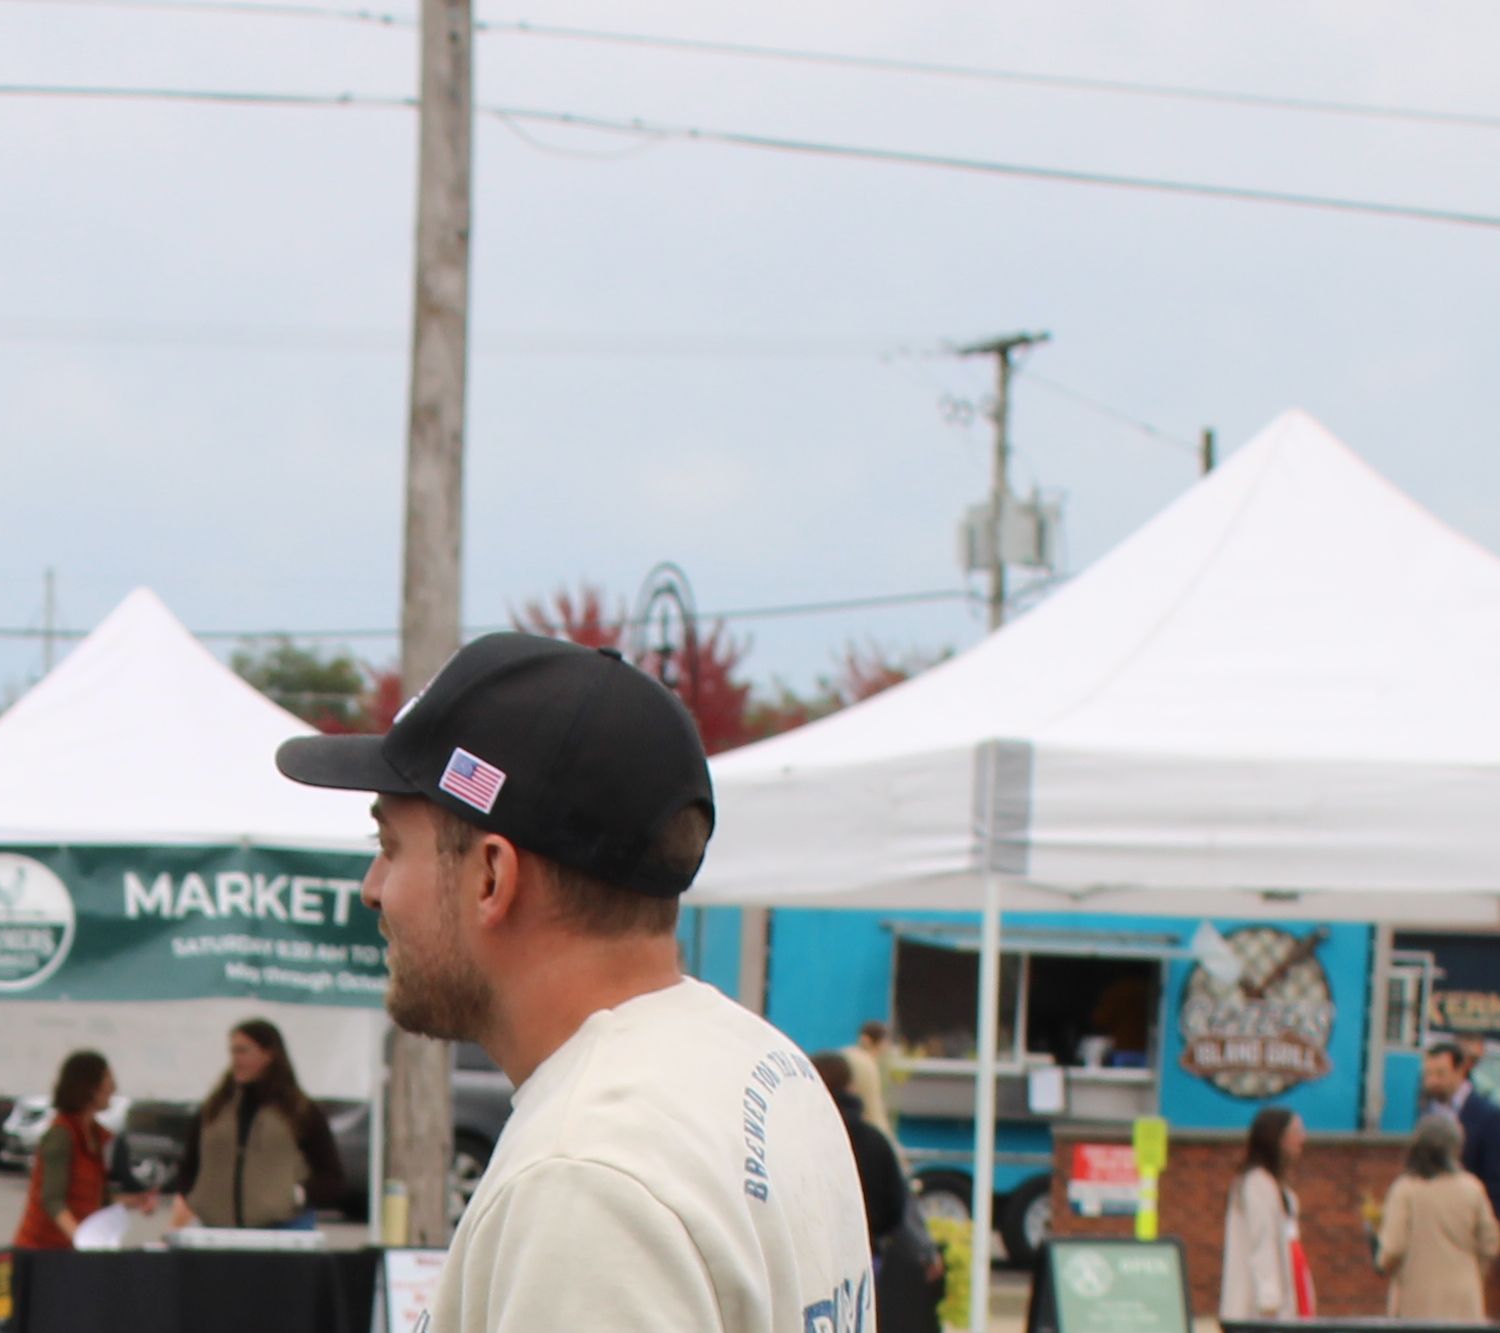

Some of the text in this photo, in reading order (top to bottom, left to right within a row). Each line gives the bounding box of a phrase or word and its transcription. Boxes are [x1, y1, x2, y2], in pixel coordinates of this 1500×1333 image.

[123, 871, 362, 927] MARKET
[171, 933, 274, 958] SATURDAY
[743, 1085, 769, 1204] BREWED
